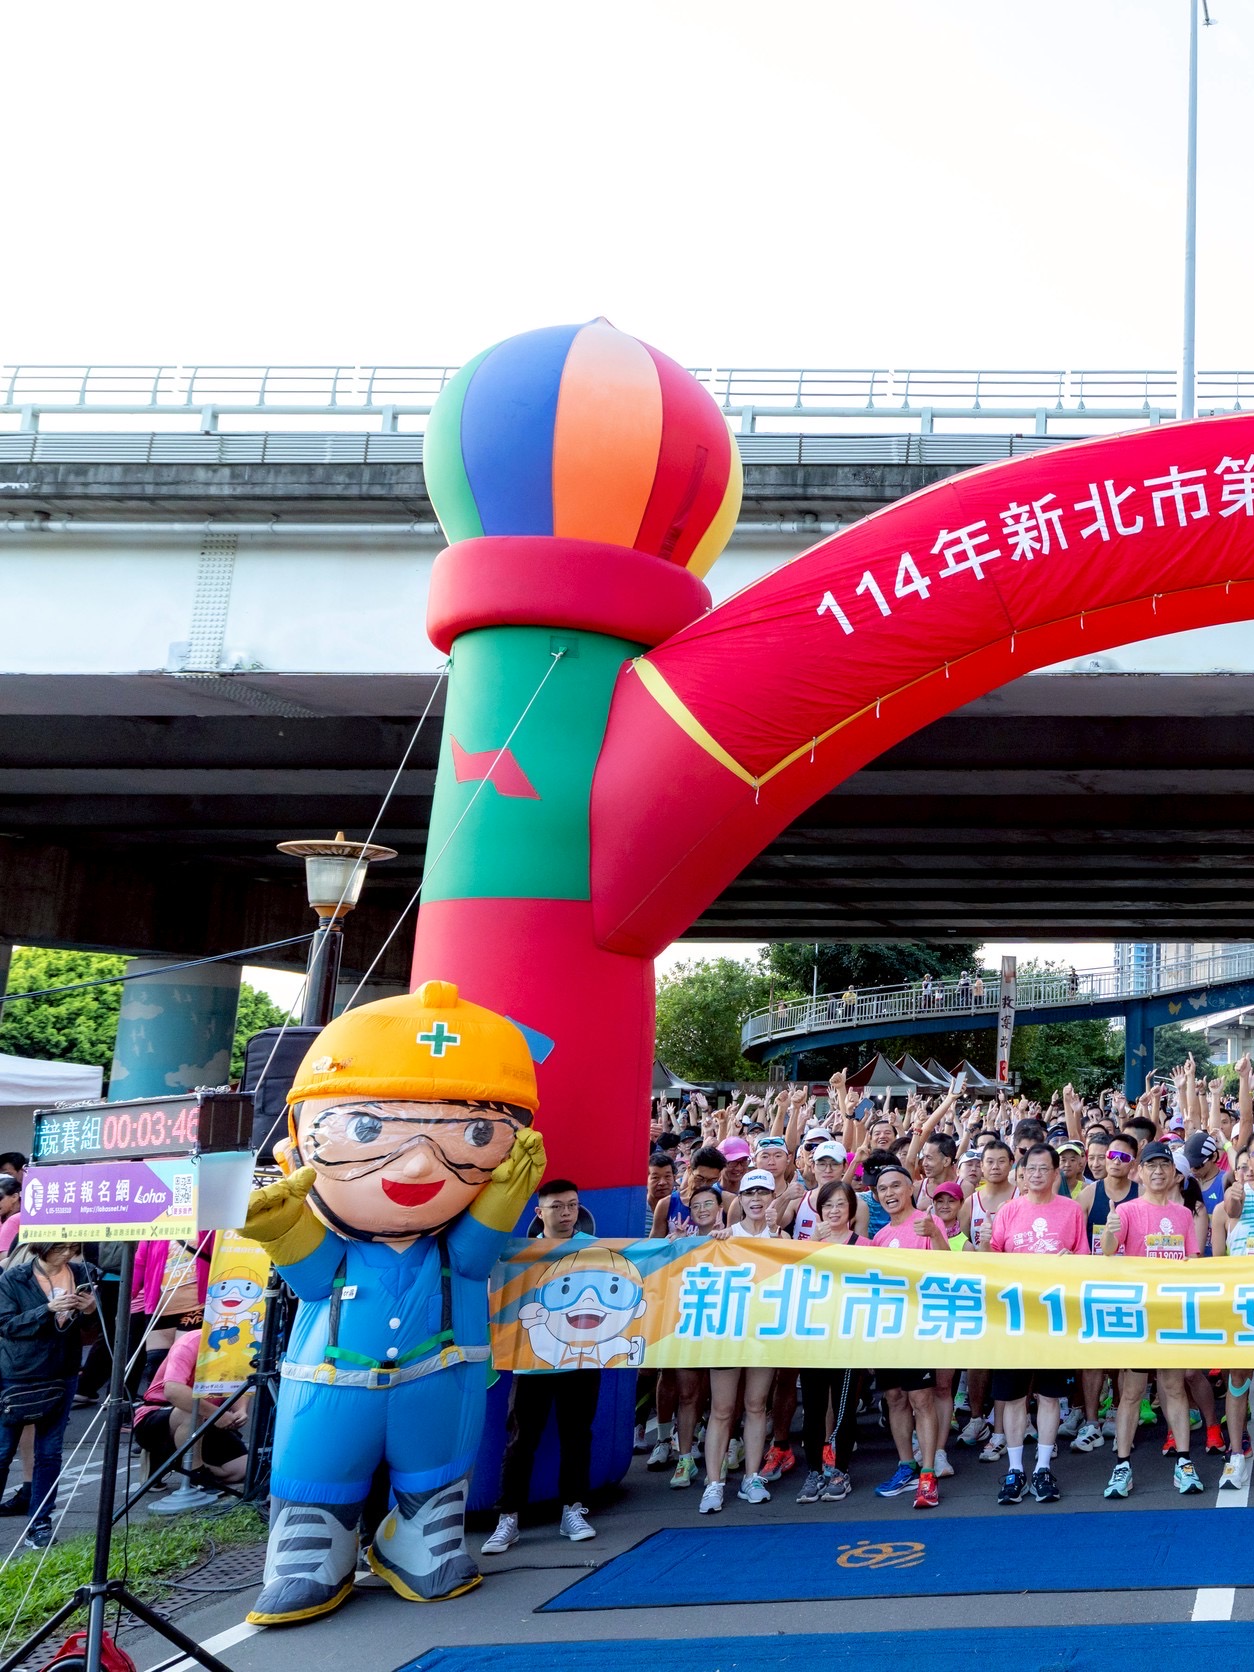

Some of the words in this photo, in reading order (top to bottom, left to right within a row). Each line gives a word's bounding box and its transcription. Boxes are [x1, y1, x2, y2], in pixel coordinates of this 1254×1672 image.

[37, 1114, 100, 1157] 競賽組
[103, 1107, 198, 1150] 00:03:46
[46, 1179, 130, 1203] 樂活報名網
[134, 1186, 166, 1204] Lohas
